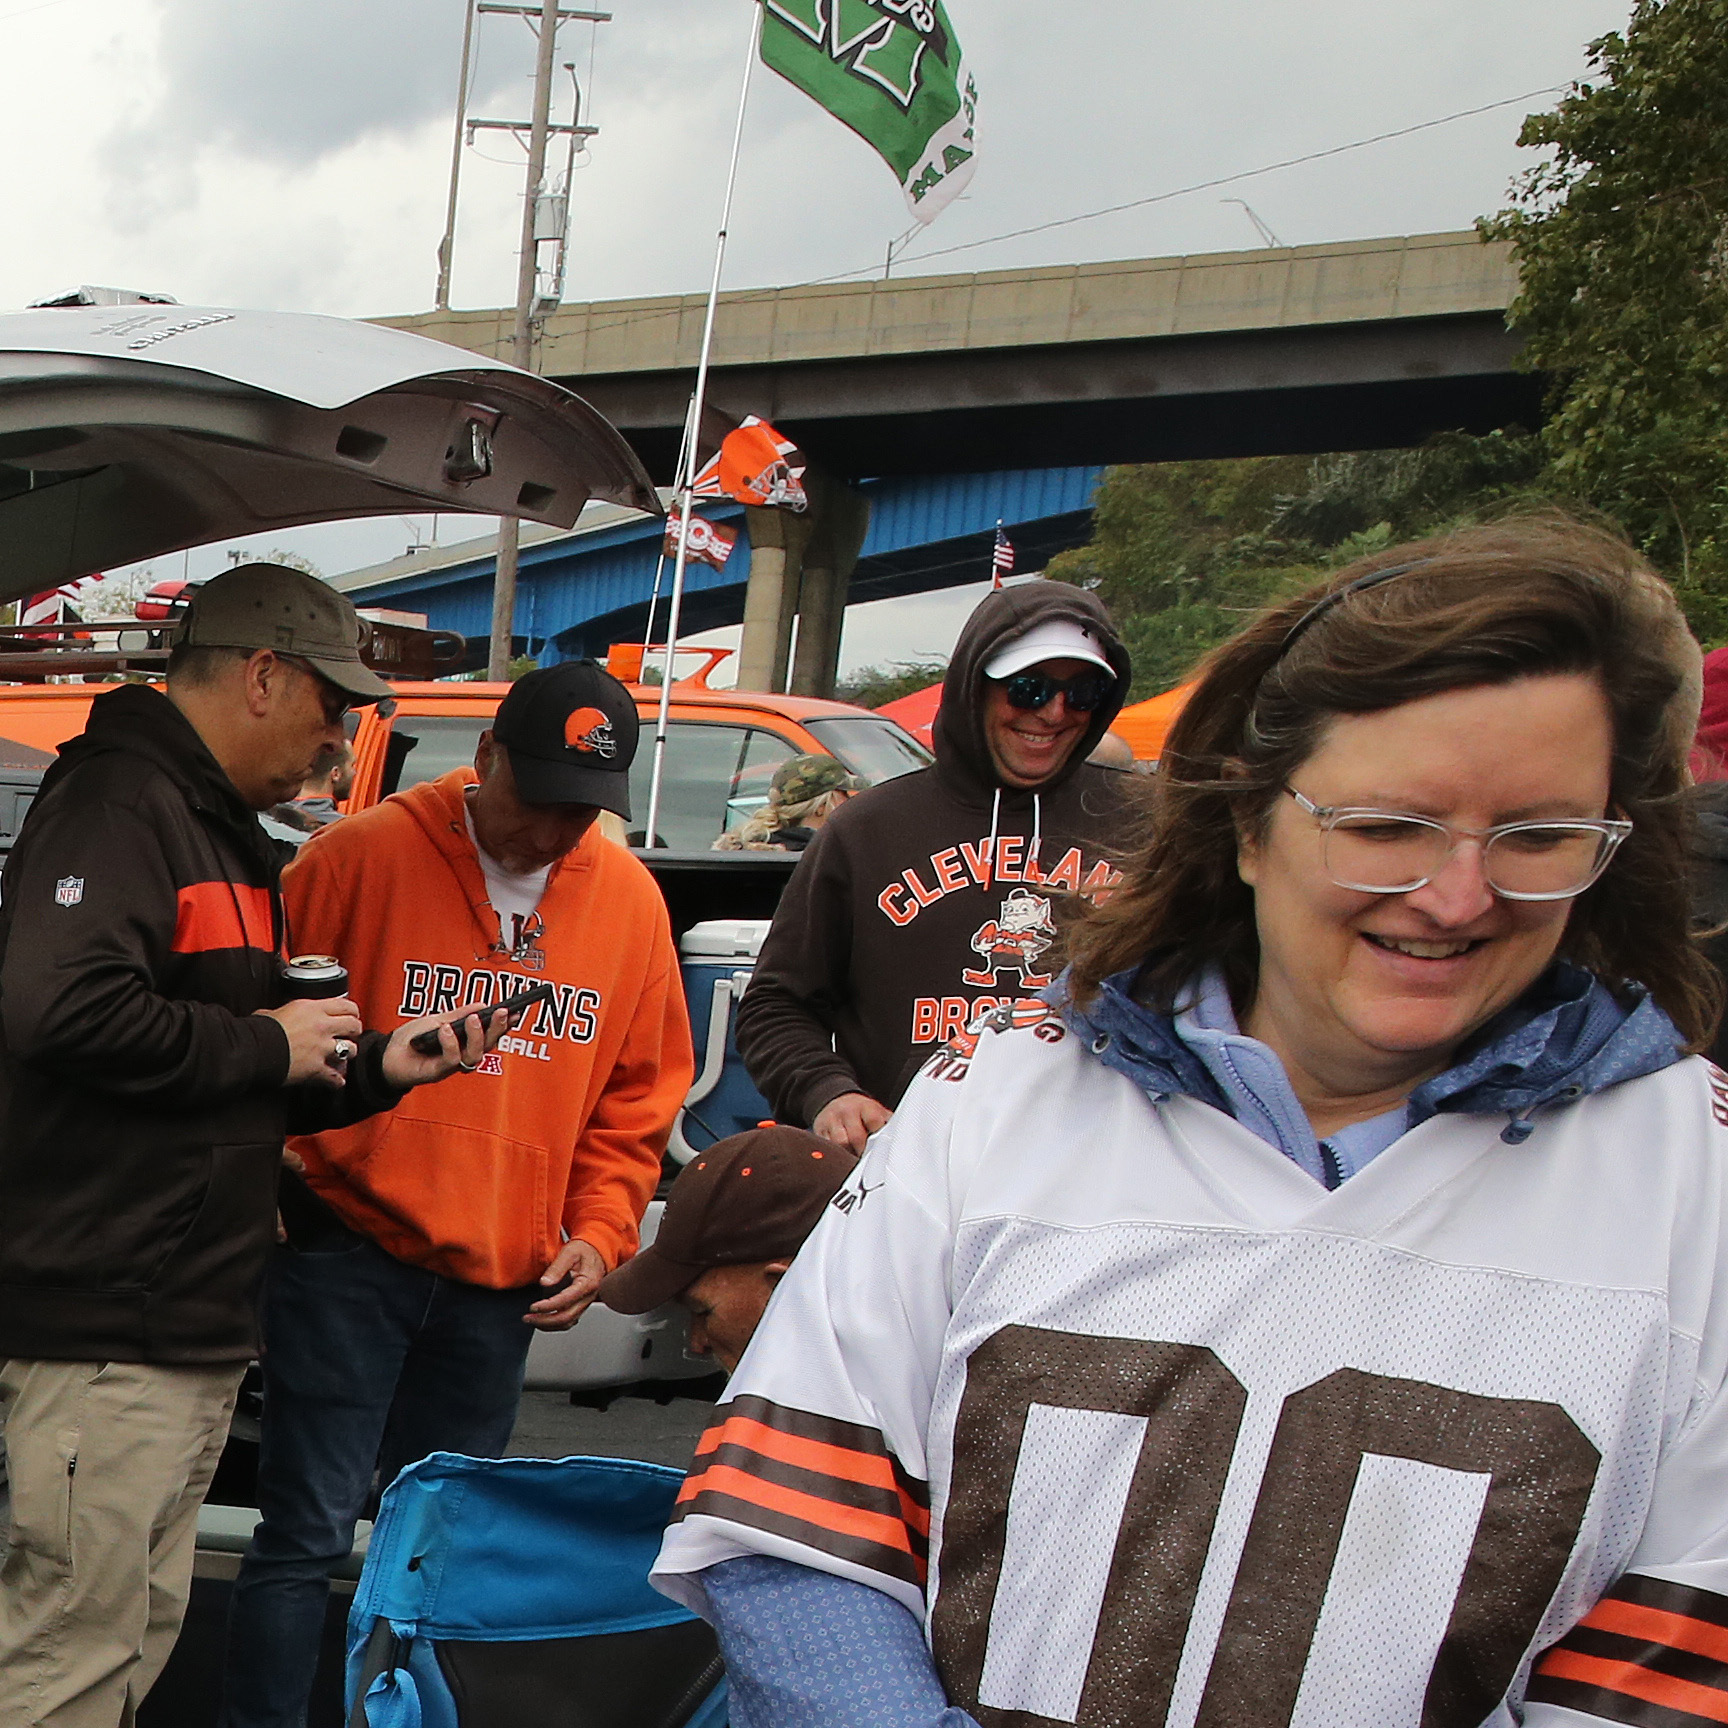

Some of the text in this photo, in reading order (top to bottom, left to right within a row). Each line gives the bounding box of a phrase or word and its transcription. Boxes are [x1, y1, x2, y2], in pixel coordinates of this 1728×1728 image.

[59, 889, 80, 902] NFL
[878, 836, 1124, 927] CLEVELAN
[911, 996, 1041, 1044] BRO
[497, 1035, 552, 1062] BALL
